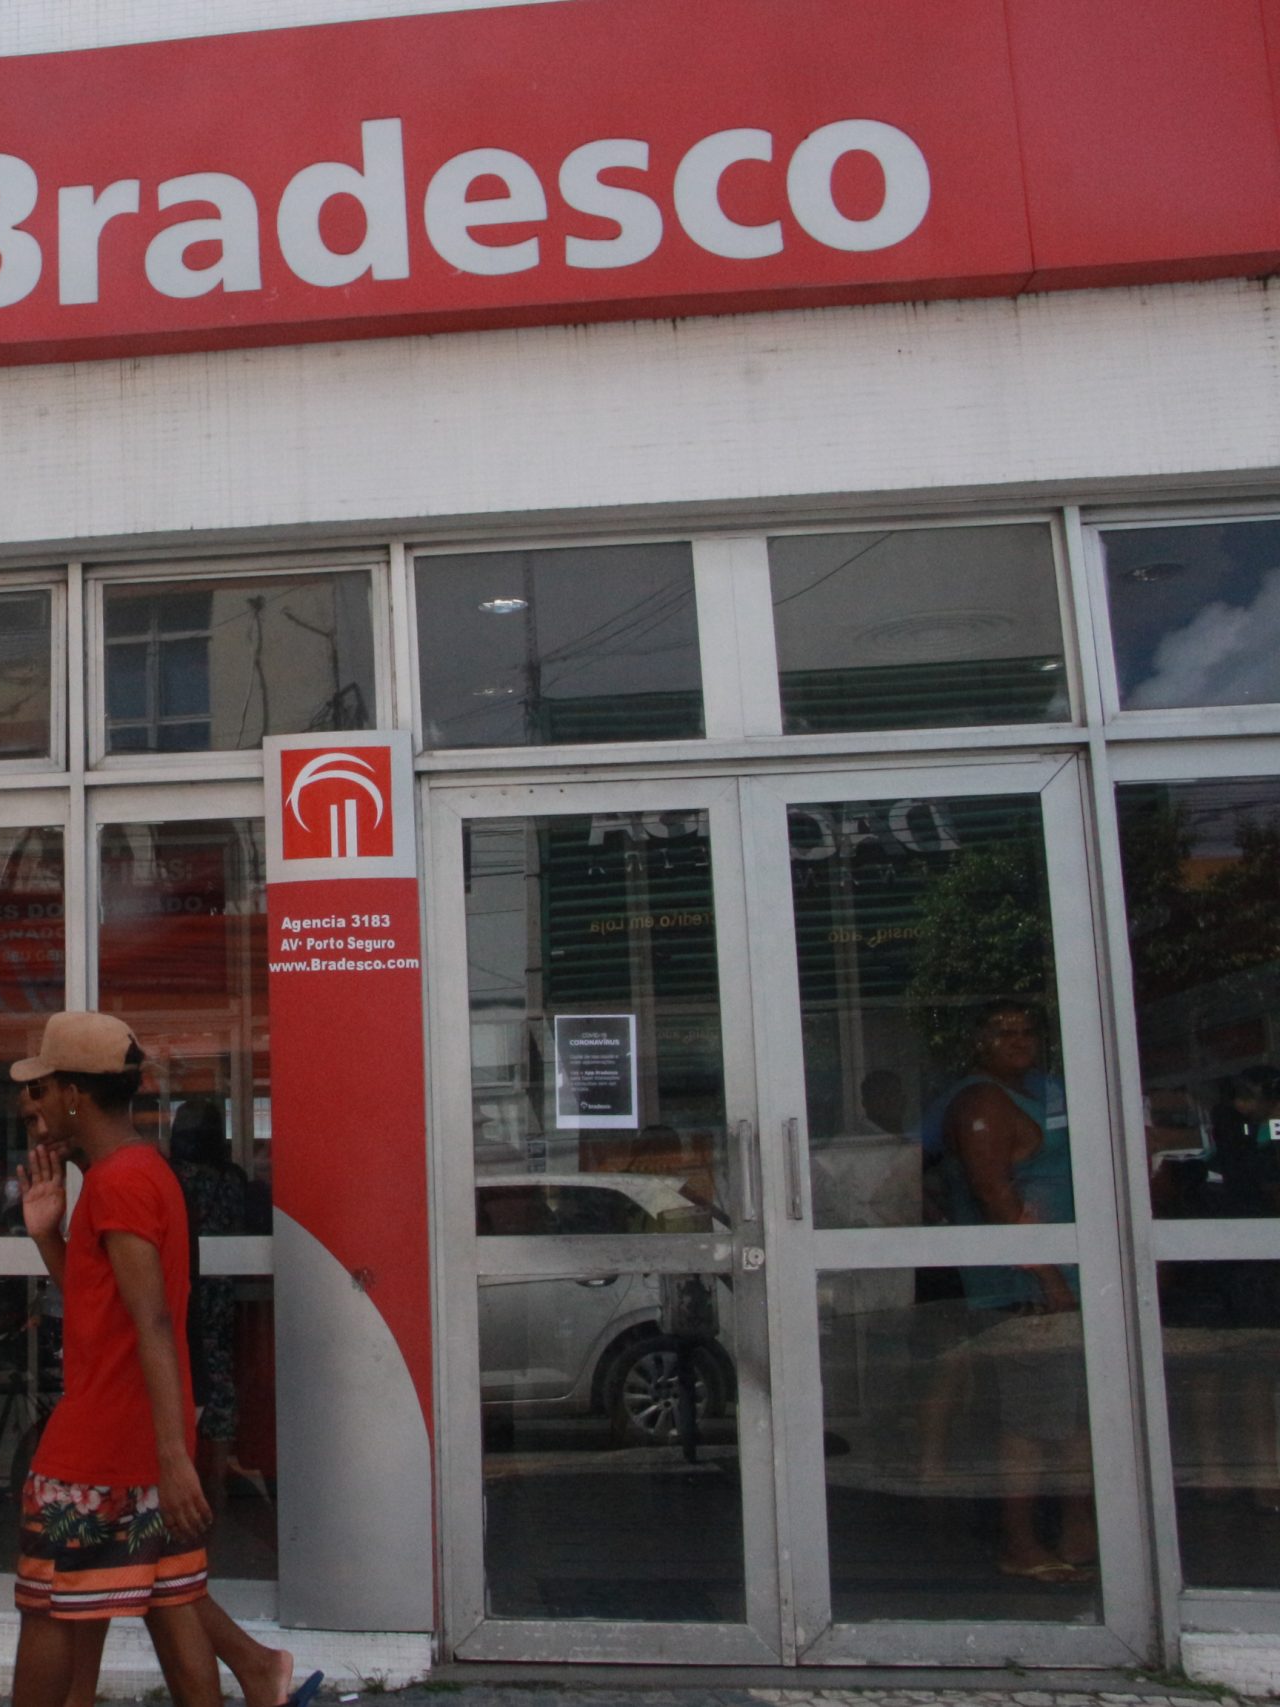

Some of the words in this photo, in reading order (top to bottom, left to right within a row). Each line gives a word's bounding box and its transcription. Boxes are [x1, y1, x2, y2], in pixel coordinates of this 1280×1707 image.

[281, 915, 346, 933] Agencia
[351, 914, 391, 928] 3183
[307, 937, 344, 950] Porto
[347, 936, 396, 952] Seguro
[269, 957, 420, 973] www.Bradesco.com
